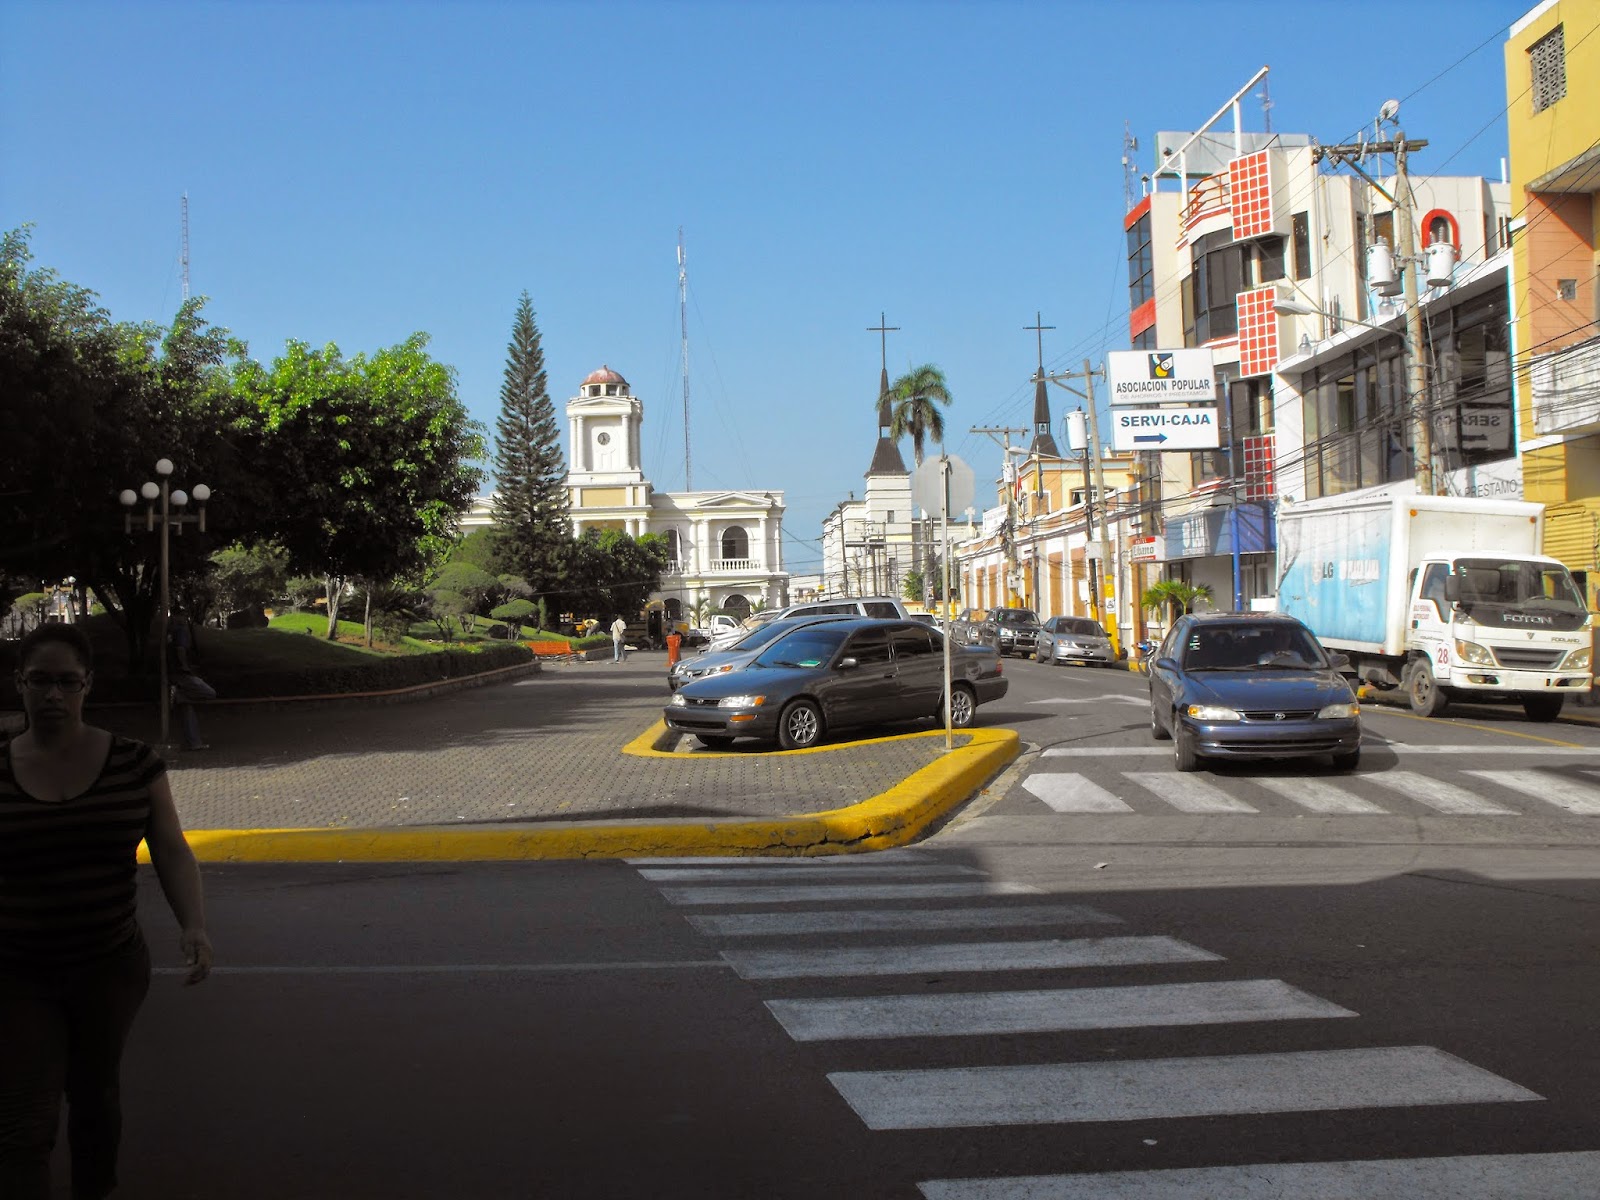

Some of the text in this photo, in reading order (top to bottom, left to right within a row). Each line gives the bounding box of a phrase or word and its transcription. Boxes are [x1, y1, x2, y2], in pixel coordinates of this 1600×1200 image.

[1116, 379, 1210, 394] ASOCIACION POPULAR
[1120, 413, 1211, 428] SERVI-CAJA
[1322, 561, 1334, 579] LG
[1503, 614, 1554, 625] FOTON
[1551, 636, 1581, 644] FORLAND
[1437, 647, 1449, 665] 28
